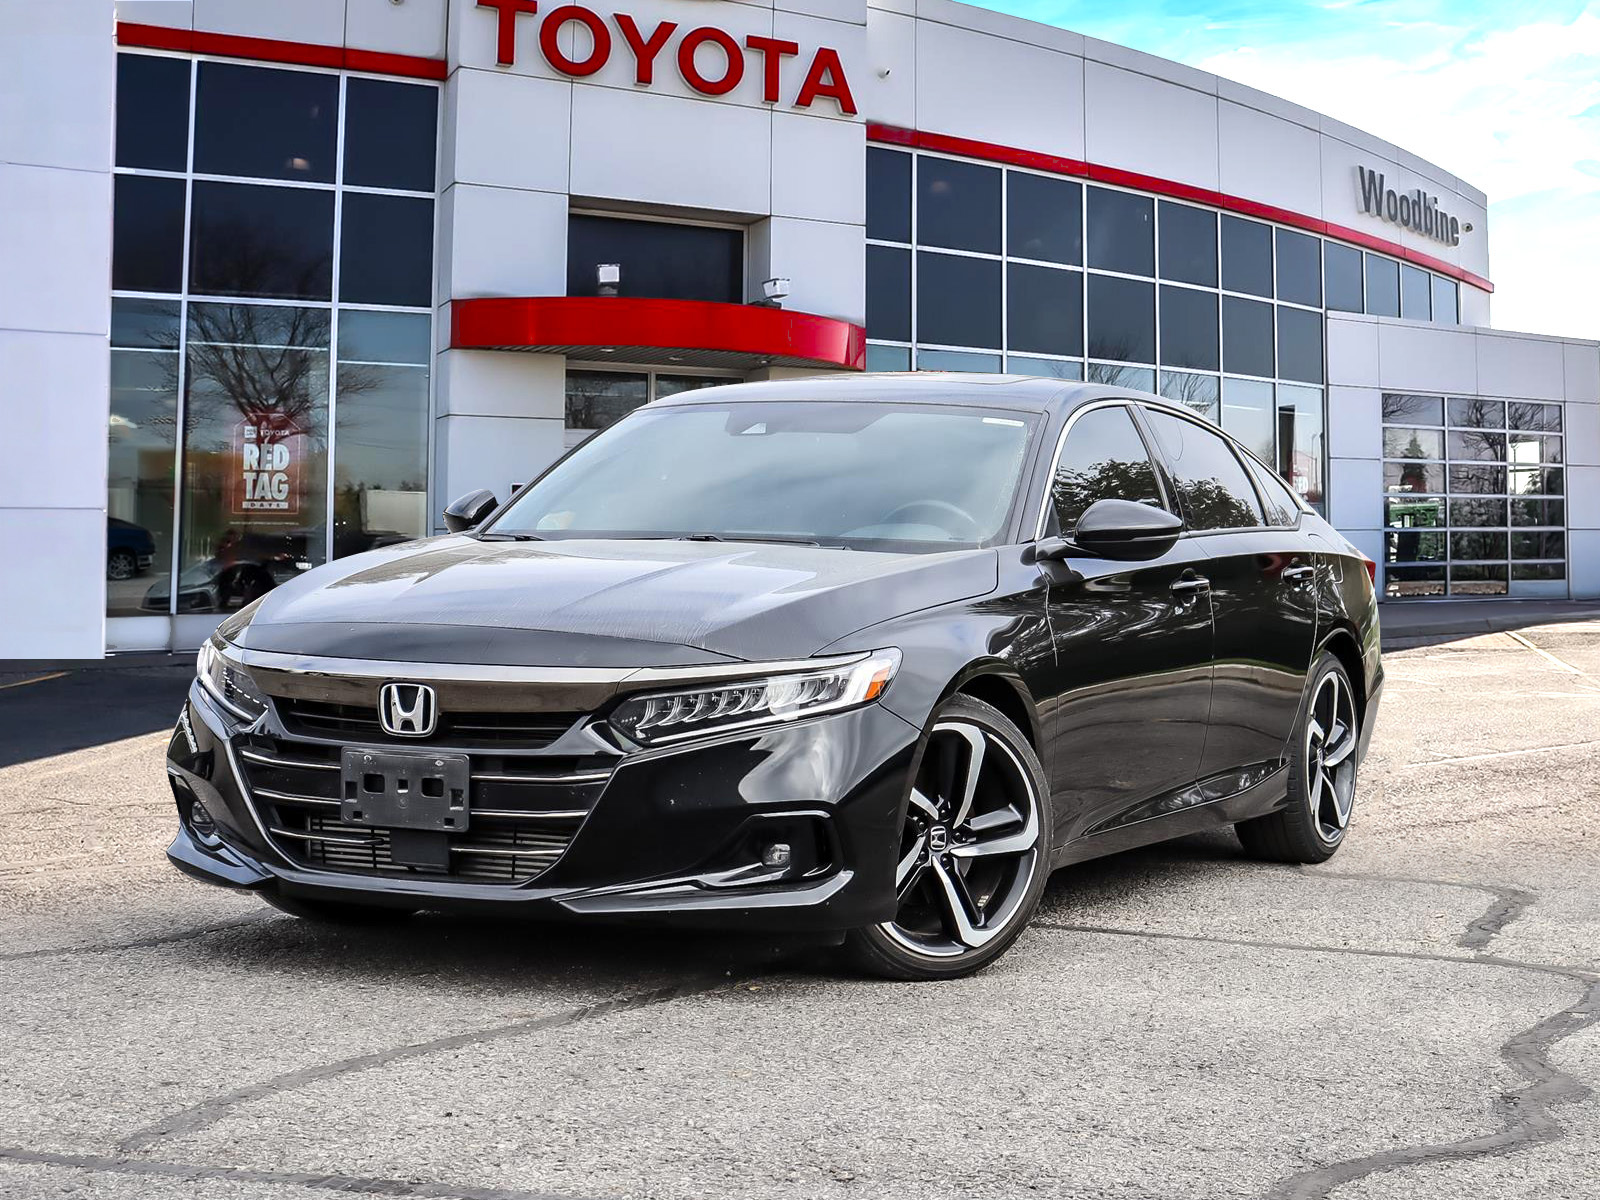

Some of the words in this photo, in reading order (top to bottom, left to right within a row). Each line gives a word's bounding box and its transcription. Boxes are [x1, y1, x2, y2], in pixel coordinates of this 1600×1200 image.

[477, 0, 858, 116] TOYOTA
[1357, 165, 1460, 247] Woodbine
[260, 429, 290, 437] TOYOTA
[243, 443, 290, 471] RED
[243, 472, 289, 500] TAG
